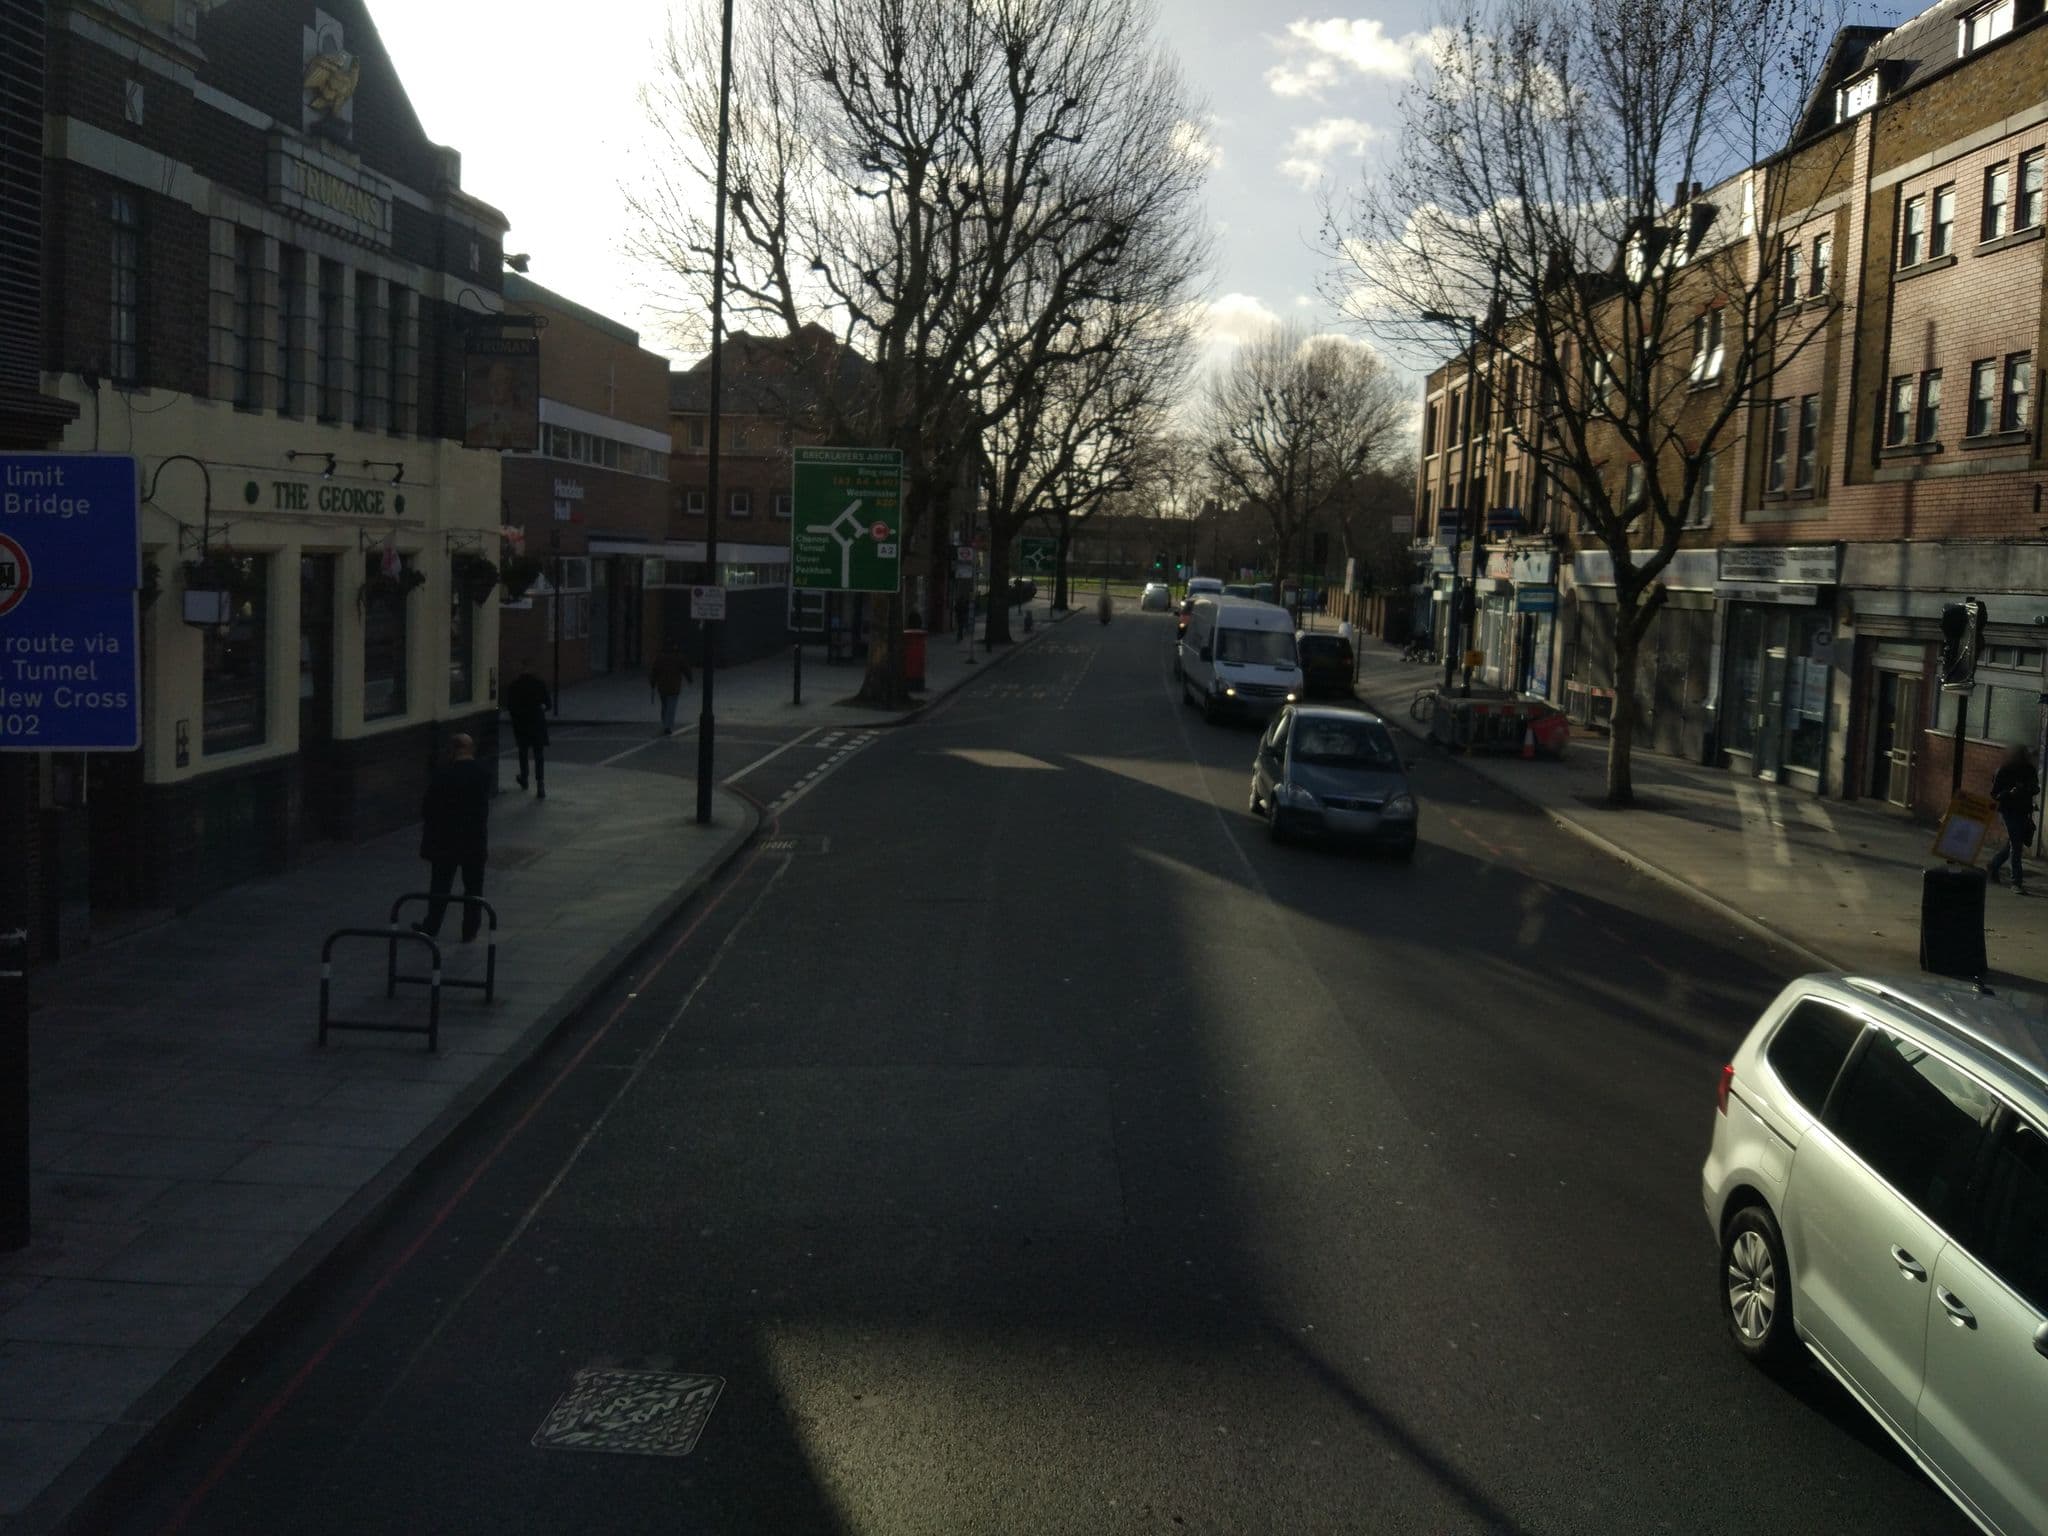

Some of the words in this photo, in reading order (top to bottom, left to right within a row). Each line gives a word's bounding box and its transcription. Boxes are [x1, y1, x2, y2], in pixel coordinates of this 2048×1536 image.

[295, 160, 377, 224] TRUMANS
[7, 465, 65, 486] limit
[4, 493, 91, 519] Bridge
[273, 482, 310, 512] THE
[320, 487, 385, 514] GEORGE
[880, 546, 895, 555] A2
[795, 567, 832, 576] Peckham
[6, 633, 75, 653] route
[84, 632, 120, 653] via
[11, 659, 98, 681] Tunnel
[54, 688, 128, 709] Cross
